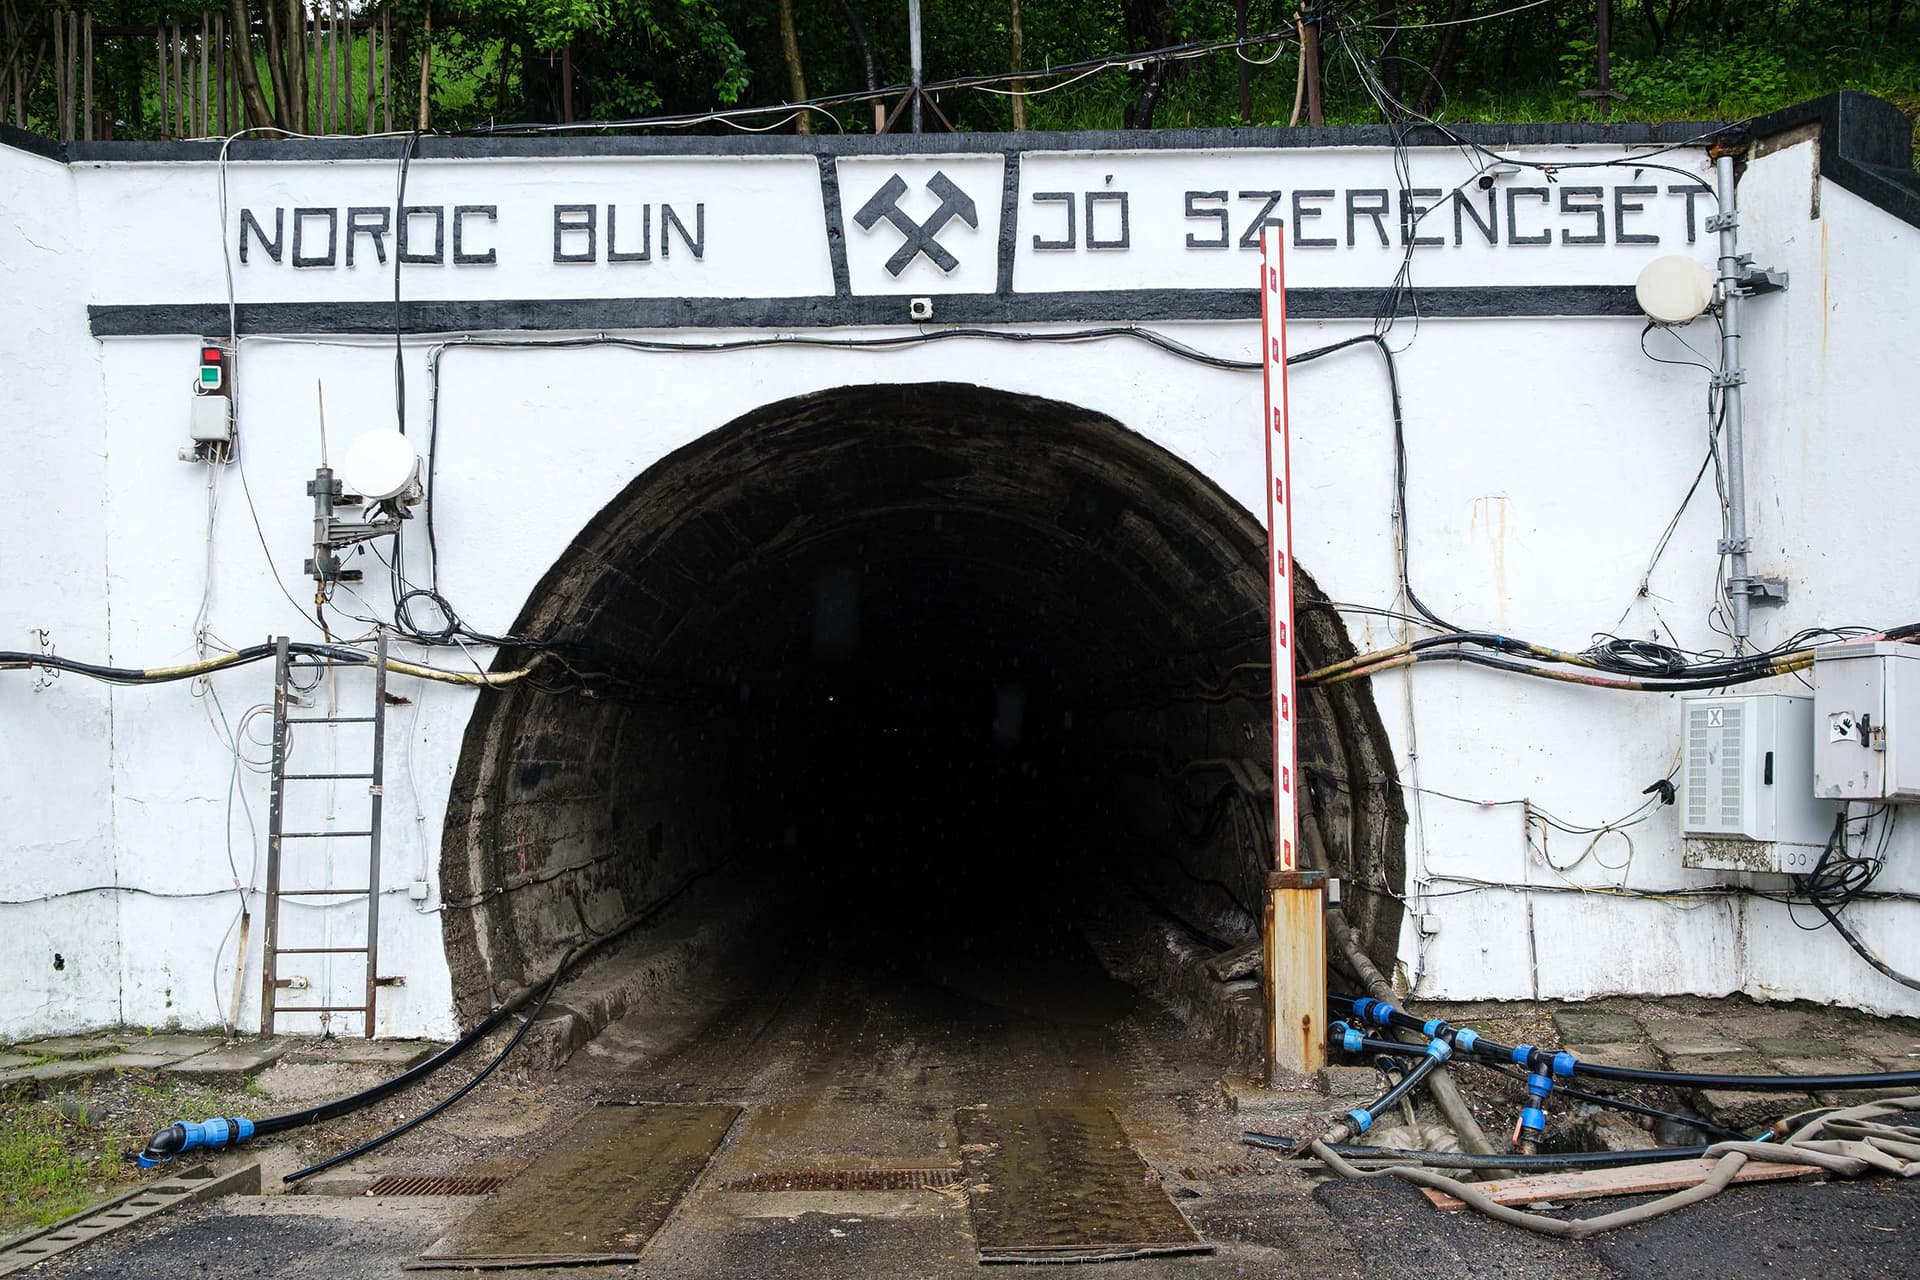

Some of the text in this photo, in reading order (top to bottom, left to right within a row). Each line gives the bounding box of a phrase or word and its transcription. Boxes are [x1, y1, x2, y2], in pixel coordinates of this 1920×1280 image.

[240, 203, 705, 268] NOROC BUN
[1032, 174, 1130, 250] JÓ
